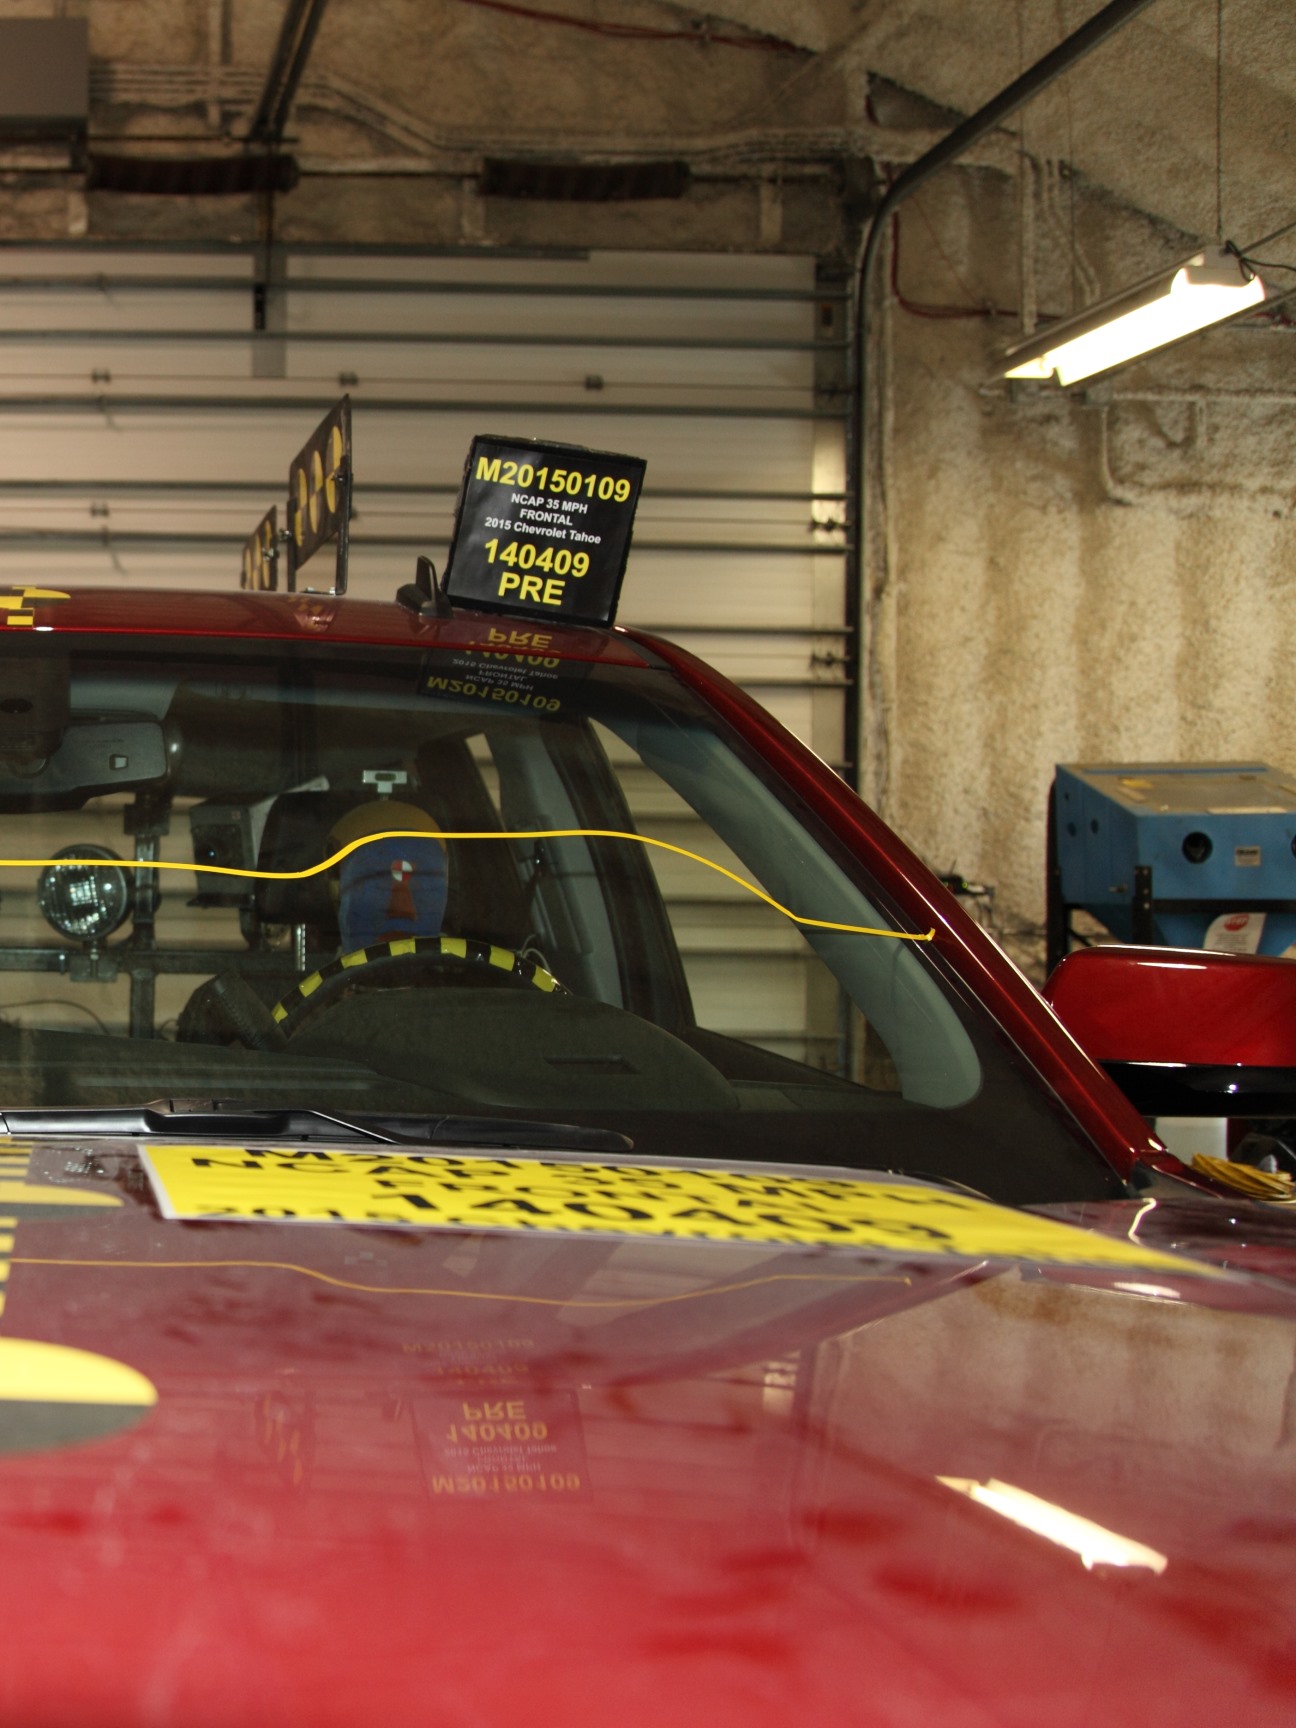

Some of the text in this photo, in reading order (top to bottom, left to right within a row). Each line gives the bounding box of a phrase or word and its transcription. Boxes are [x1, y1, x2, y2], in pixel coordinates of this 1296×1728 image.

[475, 456, 631, 503] M20150109
[511, 493, 588, 514] NCAP 35 MPH
[519, 508, 573, 526] FRONTAL
[484, 517, 601, 544] 2015 Chevrolet Tahoe
[484, 538, 590, 578] 140409
[498, 571, 565, 606] PRE
